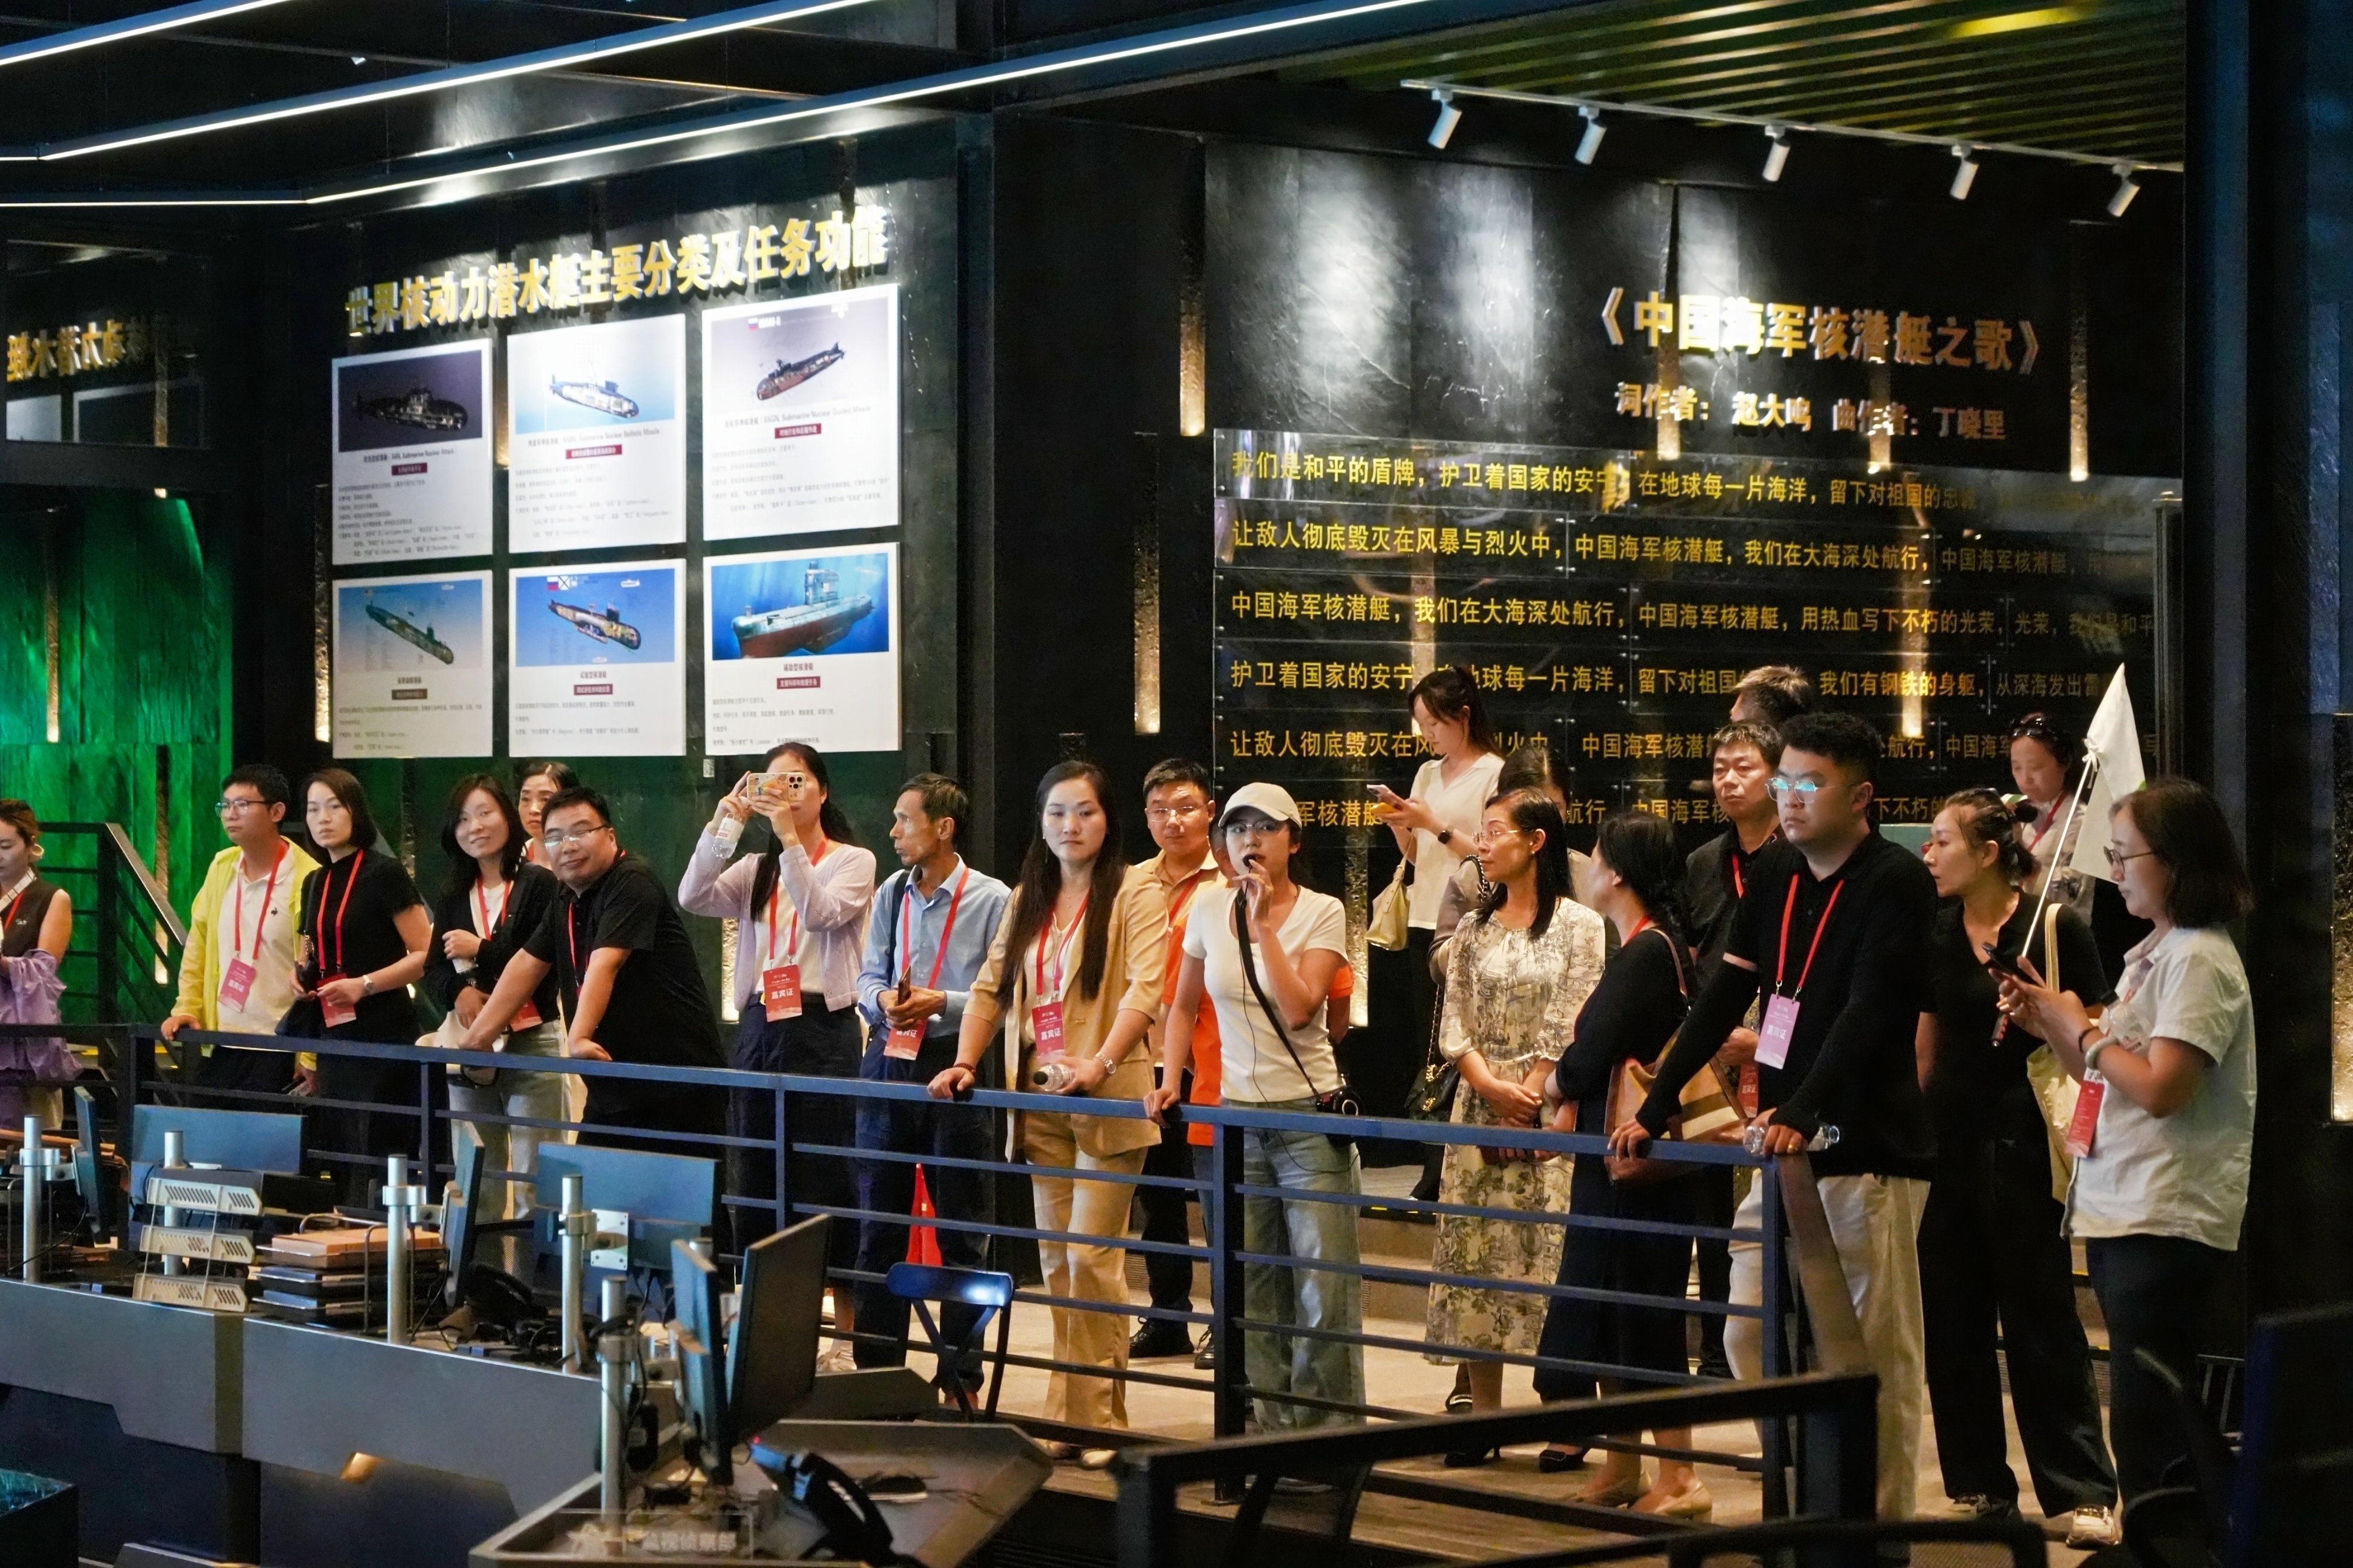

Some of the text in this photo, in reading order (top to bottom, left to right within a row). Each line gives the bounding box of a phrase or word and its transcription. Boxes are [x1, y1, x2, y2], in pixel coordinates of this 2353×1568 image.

[345, 204, 889, 337] 世界核动力潜水艇主要分类及任务功能
[1602, 286, 2039, 375] 《中国海军核潜艇之歌》
